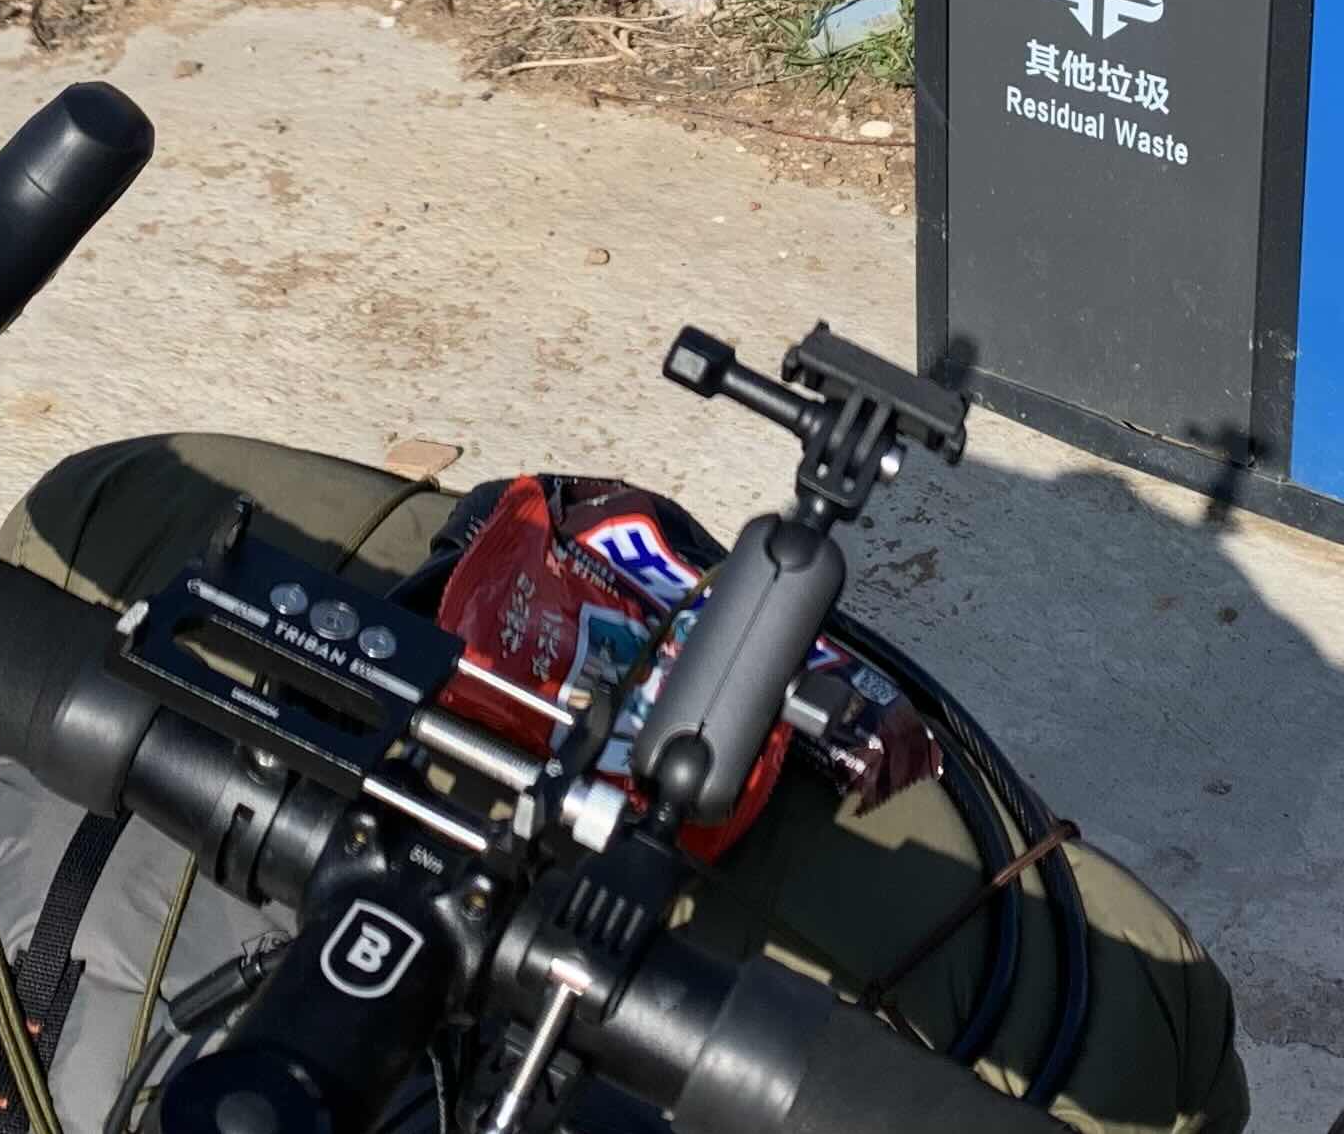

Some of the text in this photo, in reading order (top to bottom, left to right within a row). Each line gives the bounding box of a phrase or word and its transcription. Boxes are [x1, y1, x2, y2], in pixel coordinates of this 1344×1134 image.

[1025, 39, 1170, 115] 其他垃圾
[1006, 87, 1189, 165] Residual Waste
[273, 619, 347, 666] TRIBAN
